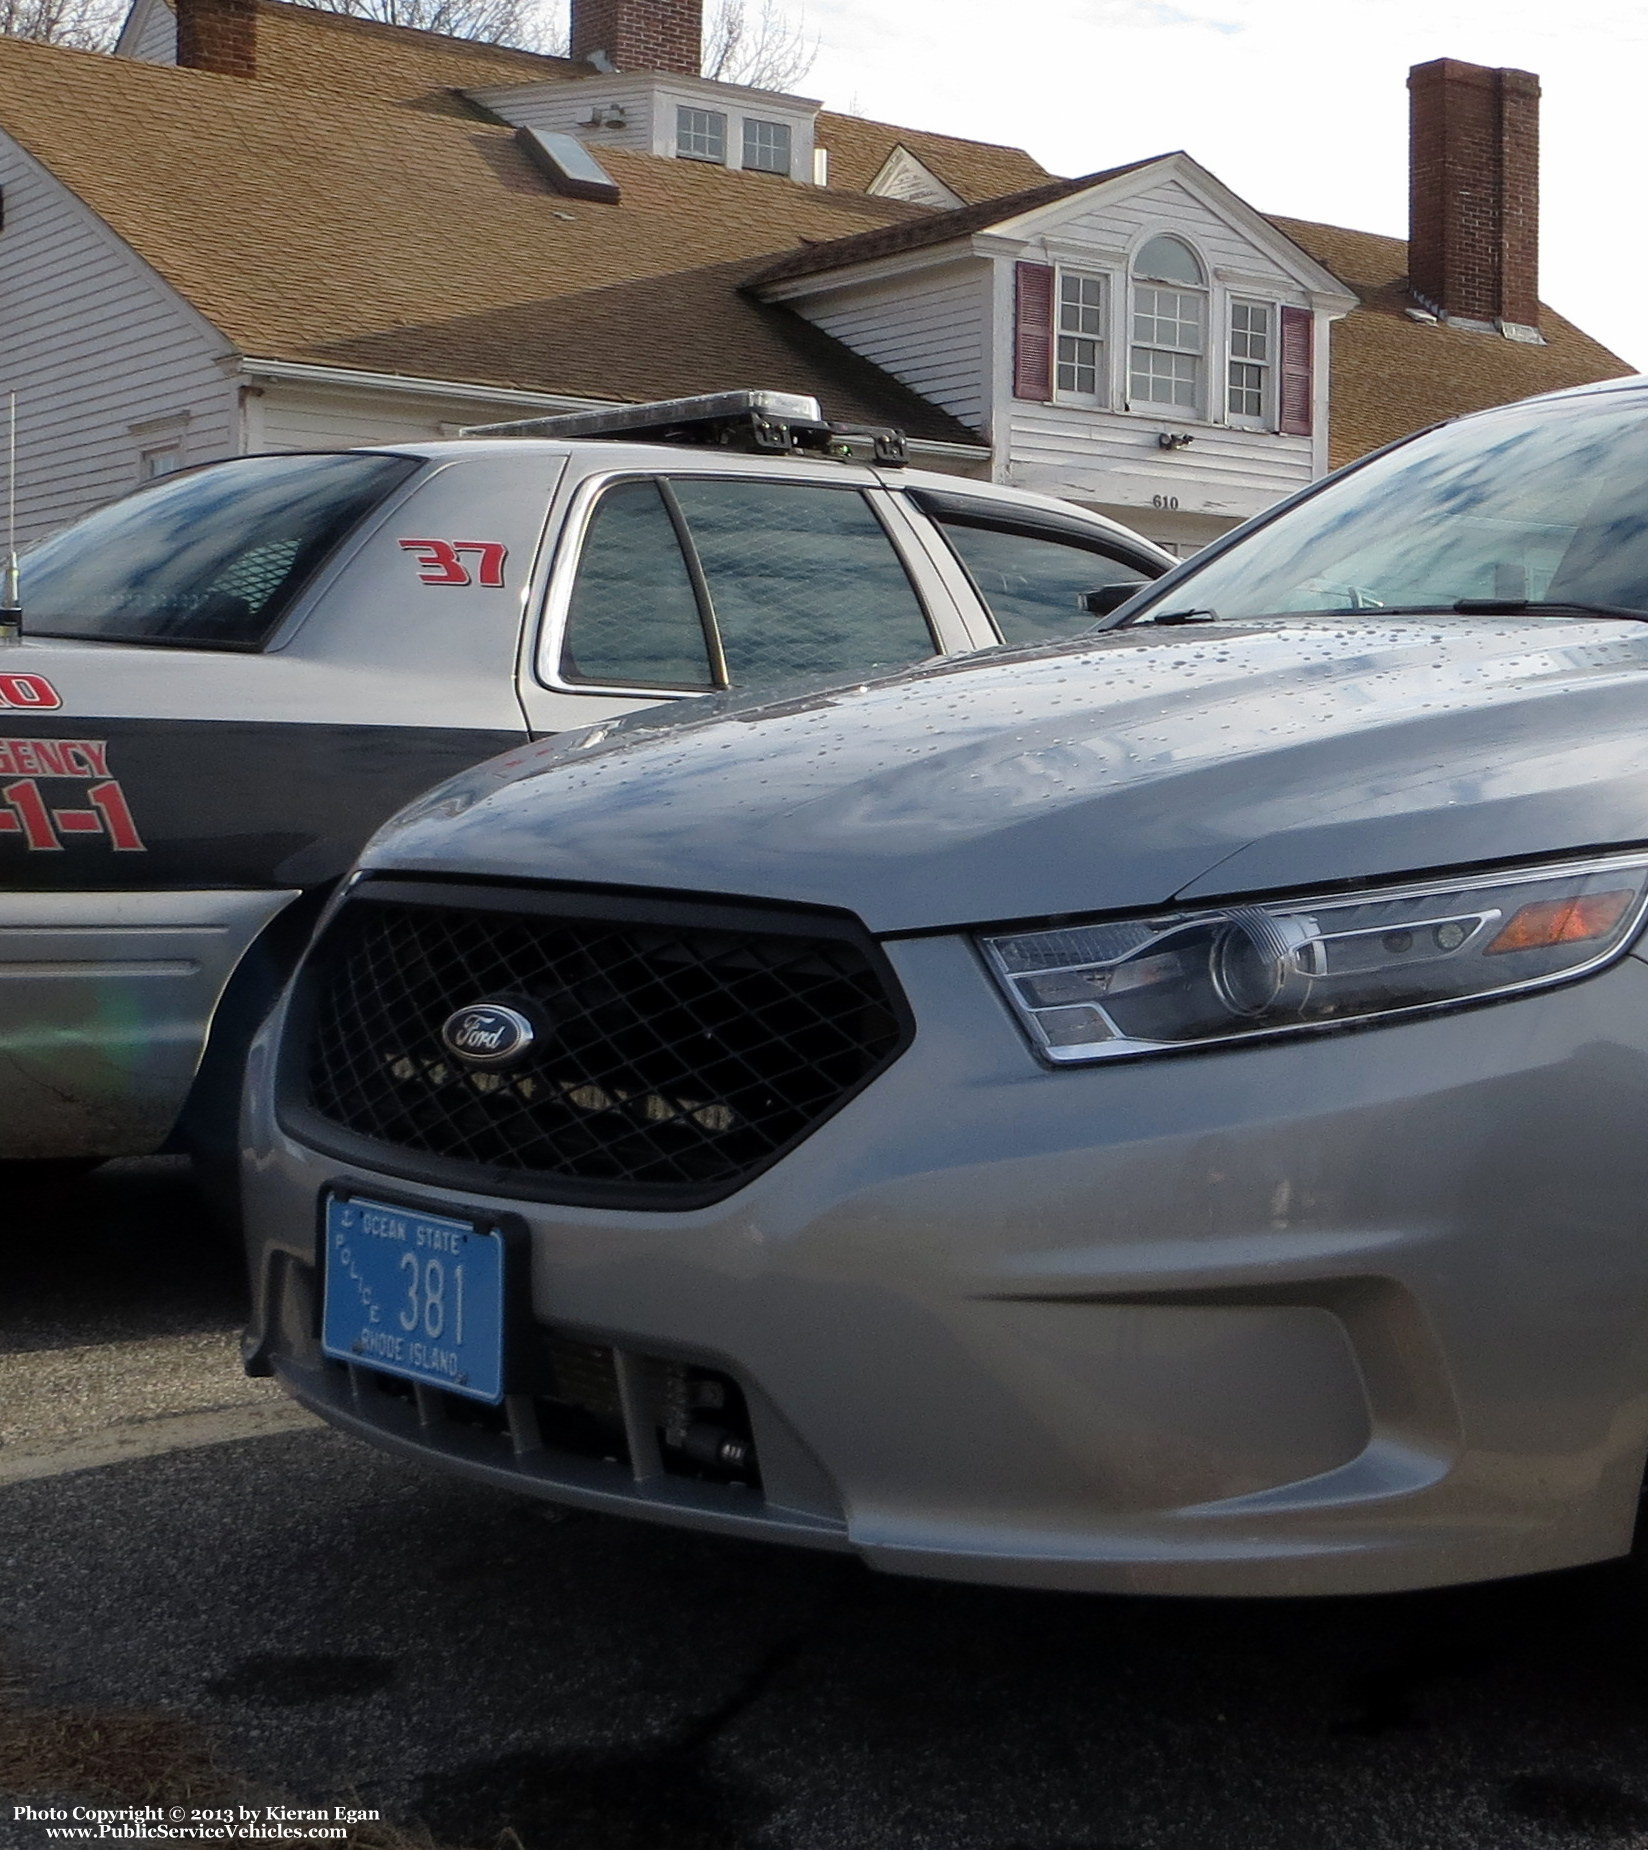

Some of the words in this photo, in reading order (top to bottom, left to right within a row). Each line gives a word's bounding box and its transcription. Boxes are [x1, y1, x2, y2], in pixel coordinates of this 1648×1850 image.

[1152, 494, 1179, 511] 610
[397, 538, 508, 588] 37
[455, 1013, 506, 1049] Ford
[363, 1213, 406, 1241] OCEAN
[416, 1225, 460, 1255] STATE
[334, 1233, 380, 1323] POLICE
[400, 1252, 464, 1345] 381
[361, 1327, 404, 1361] RHODE
[409, 1341, 457, 1376] ISLAND
